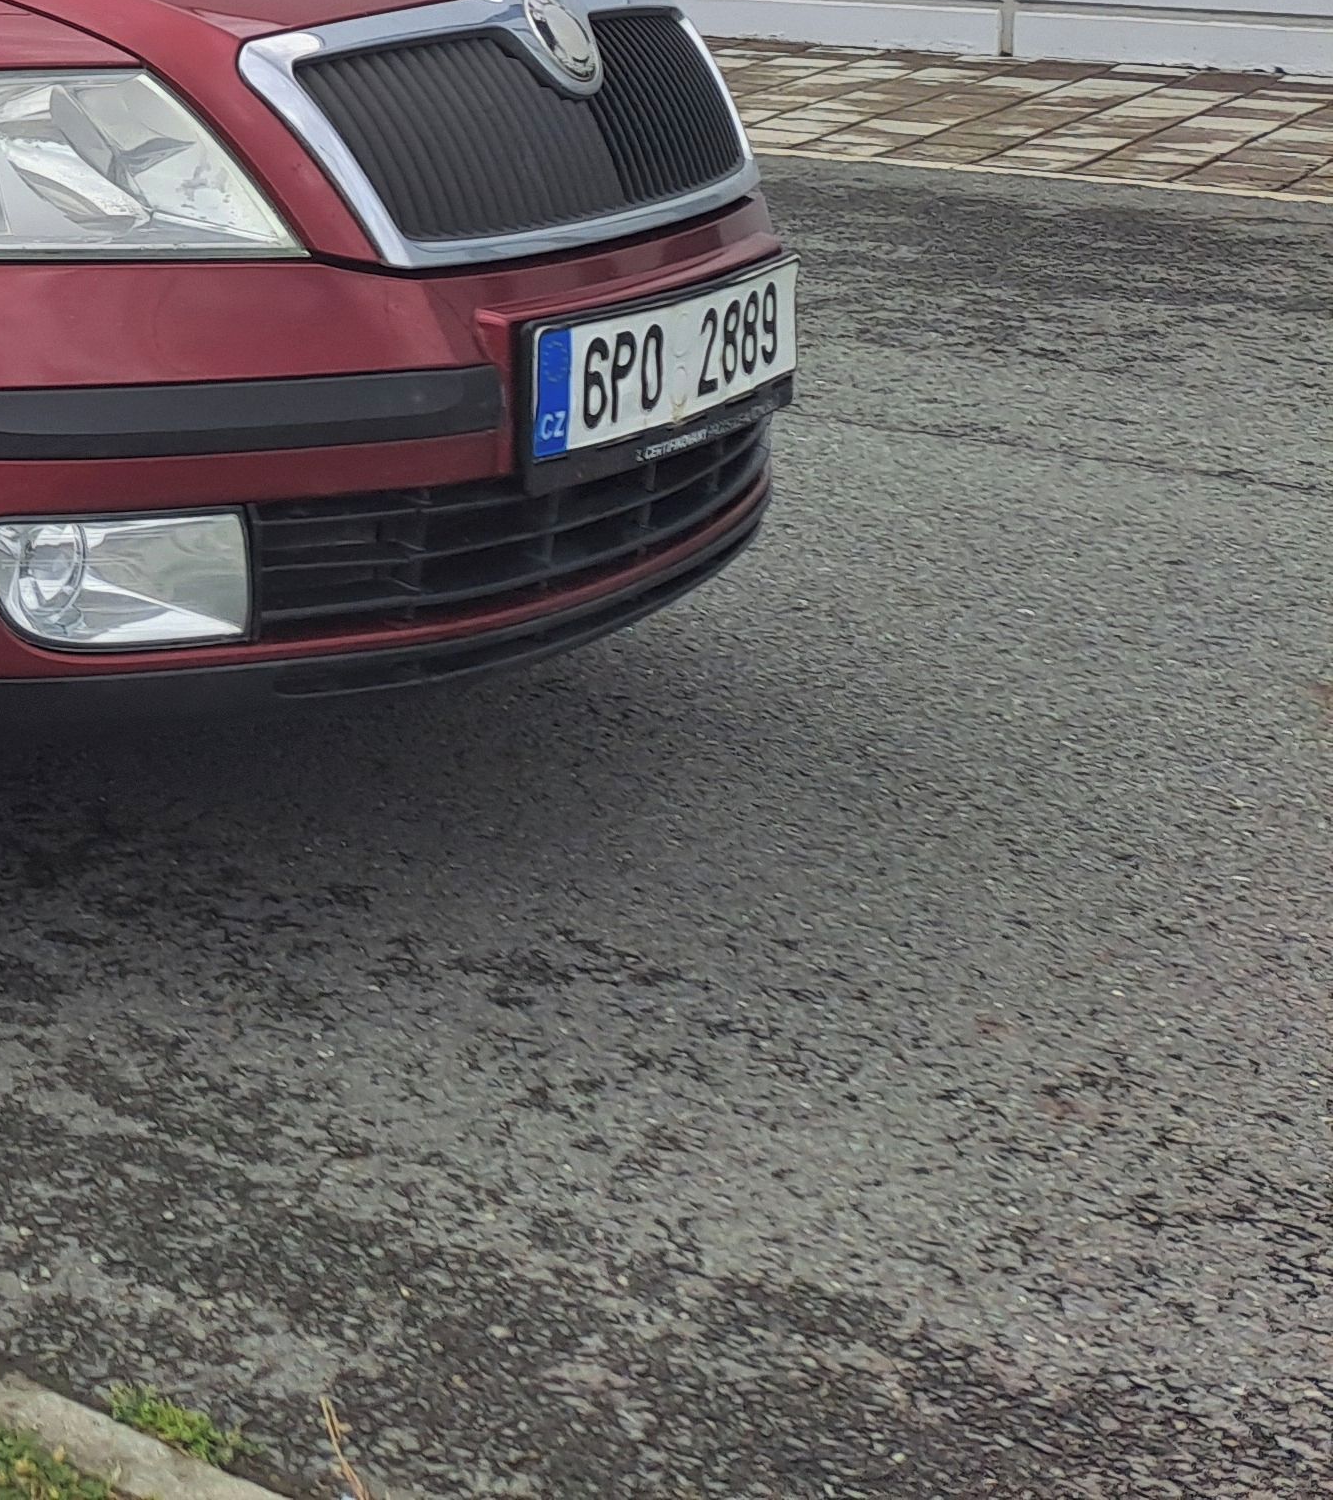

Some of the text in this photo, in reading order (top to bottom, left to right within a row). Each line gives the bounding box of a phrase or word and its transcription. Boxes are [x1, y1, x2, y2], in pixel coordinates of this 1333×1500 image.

[583, 281, 778, 430] 6P0 2889
[540, 411, 567, 441] CZ
